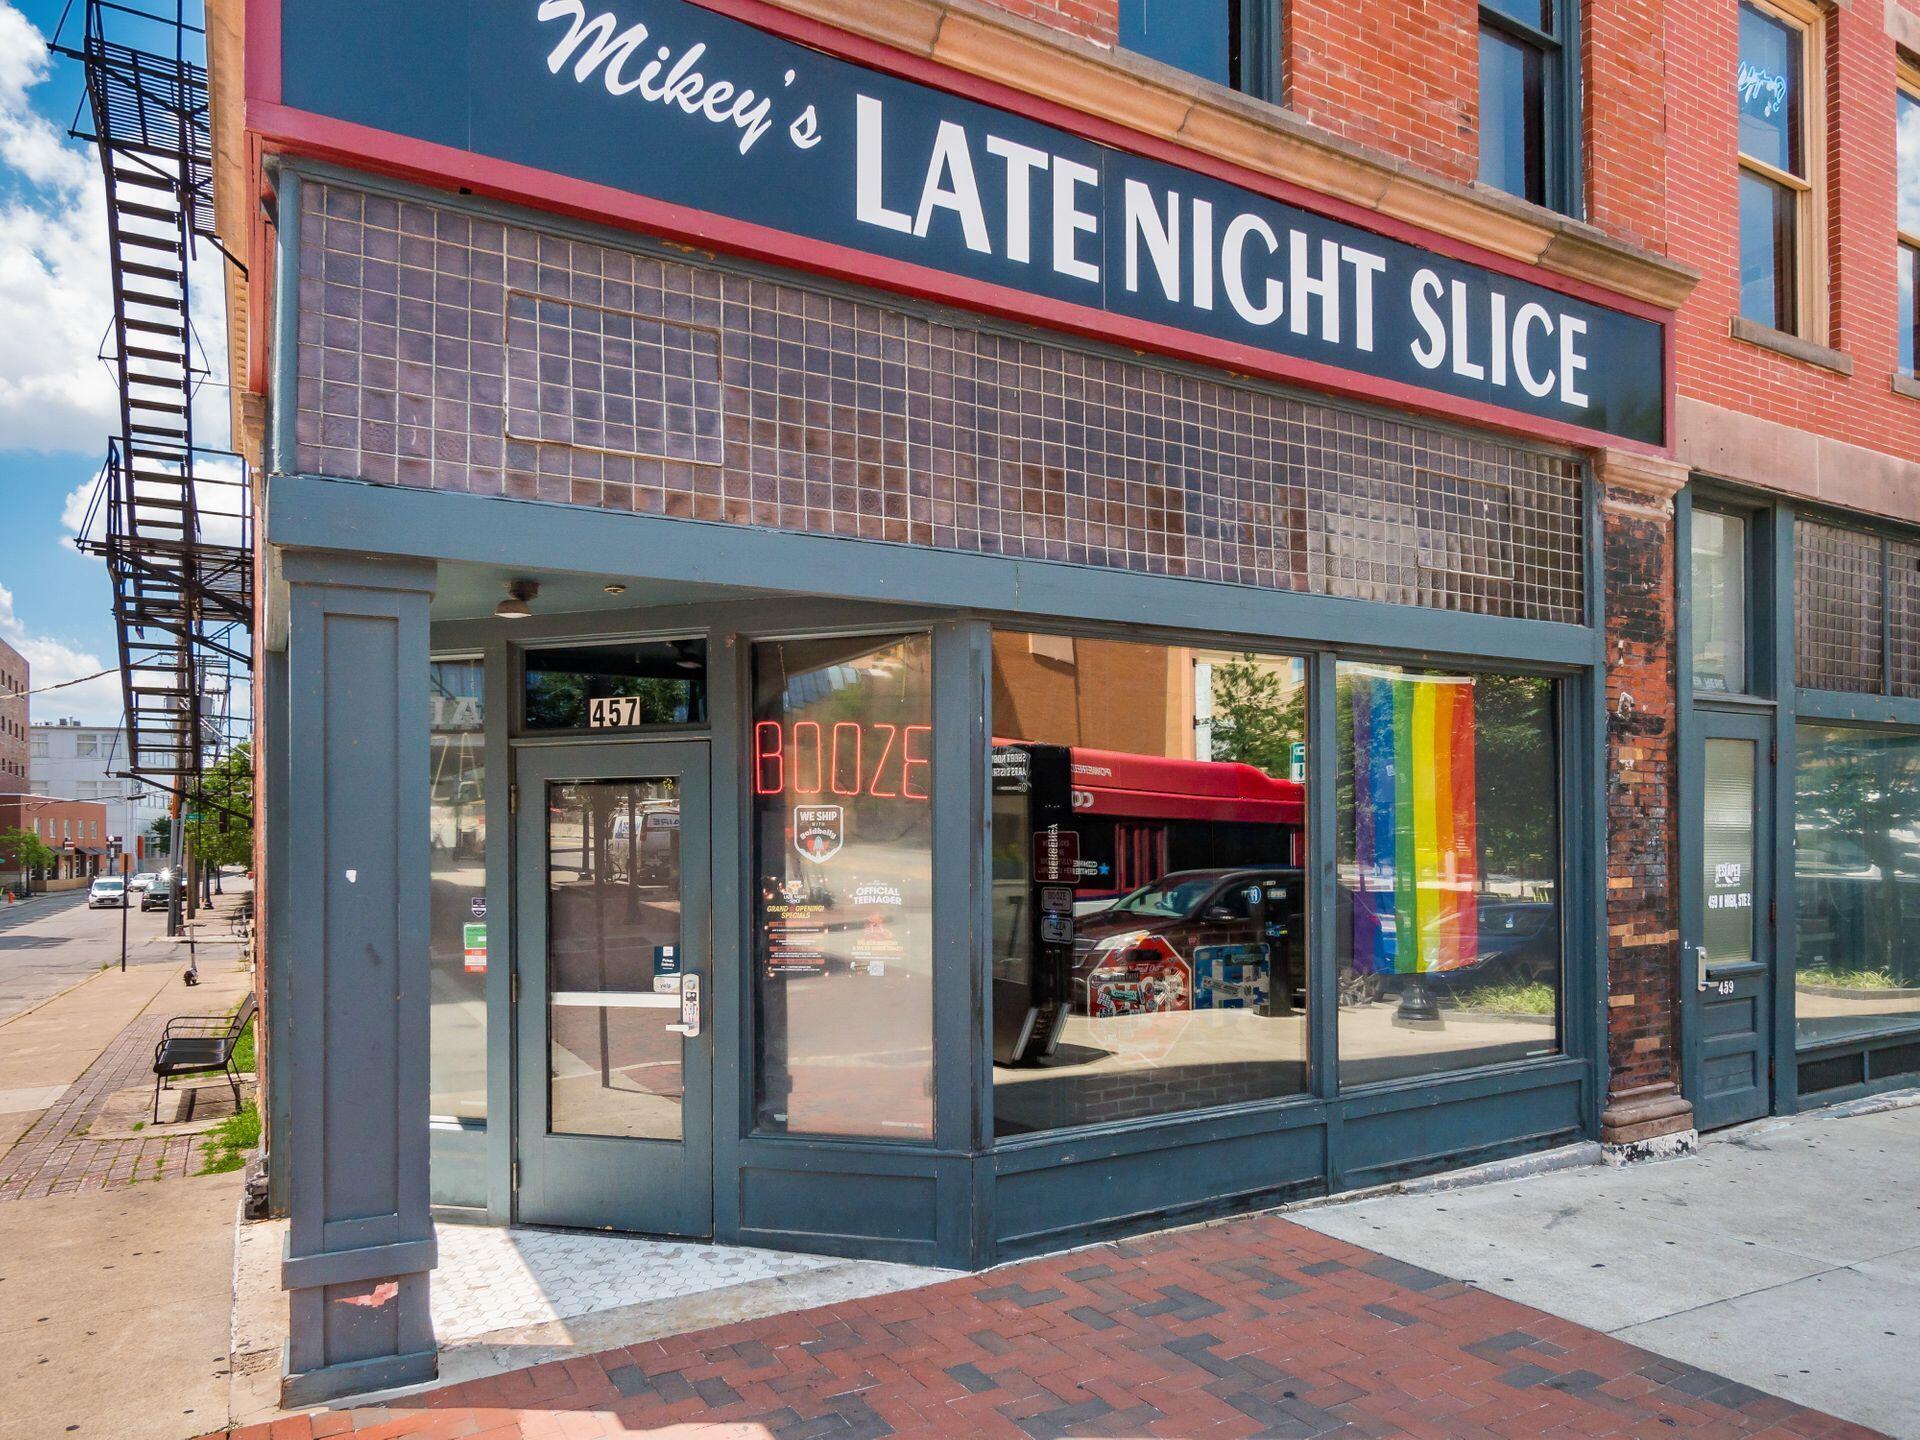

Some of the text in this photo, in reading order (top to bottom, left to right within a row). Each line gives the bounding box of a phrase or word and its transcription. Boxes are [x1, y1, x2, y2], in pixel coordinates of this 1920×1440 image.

[537, 0, 1589, 408] Mikey's LATE NIGHT SLICE
[592, 697, 638, 727] 457
[755, 721, 932, 800] BOOZE
[800, 811, 837, 821] WE SHIP
[855, 886, 901, 897] OFFICIAL
[853, 895, 903, 906] TEENAGER
[766, 905, 789, 913] GRAND
[1718, 980, 1734, 995] 459
